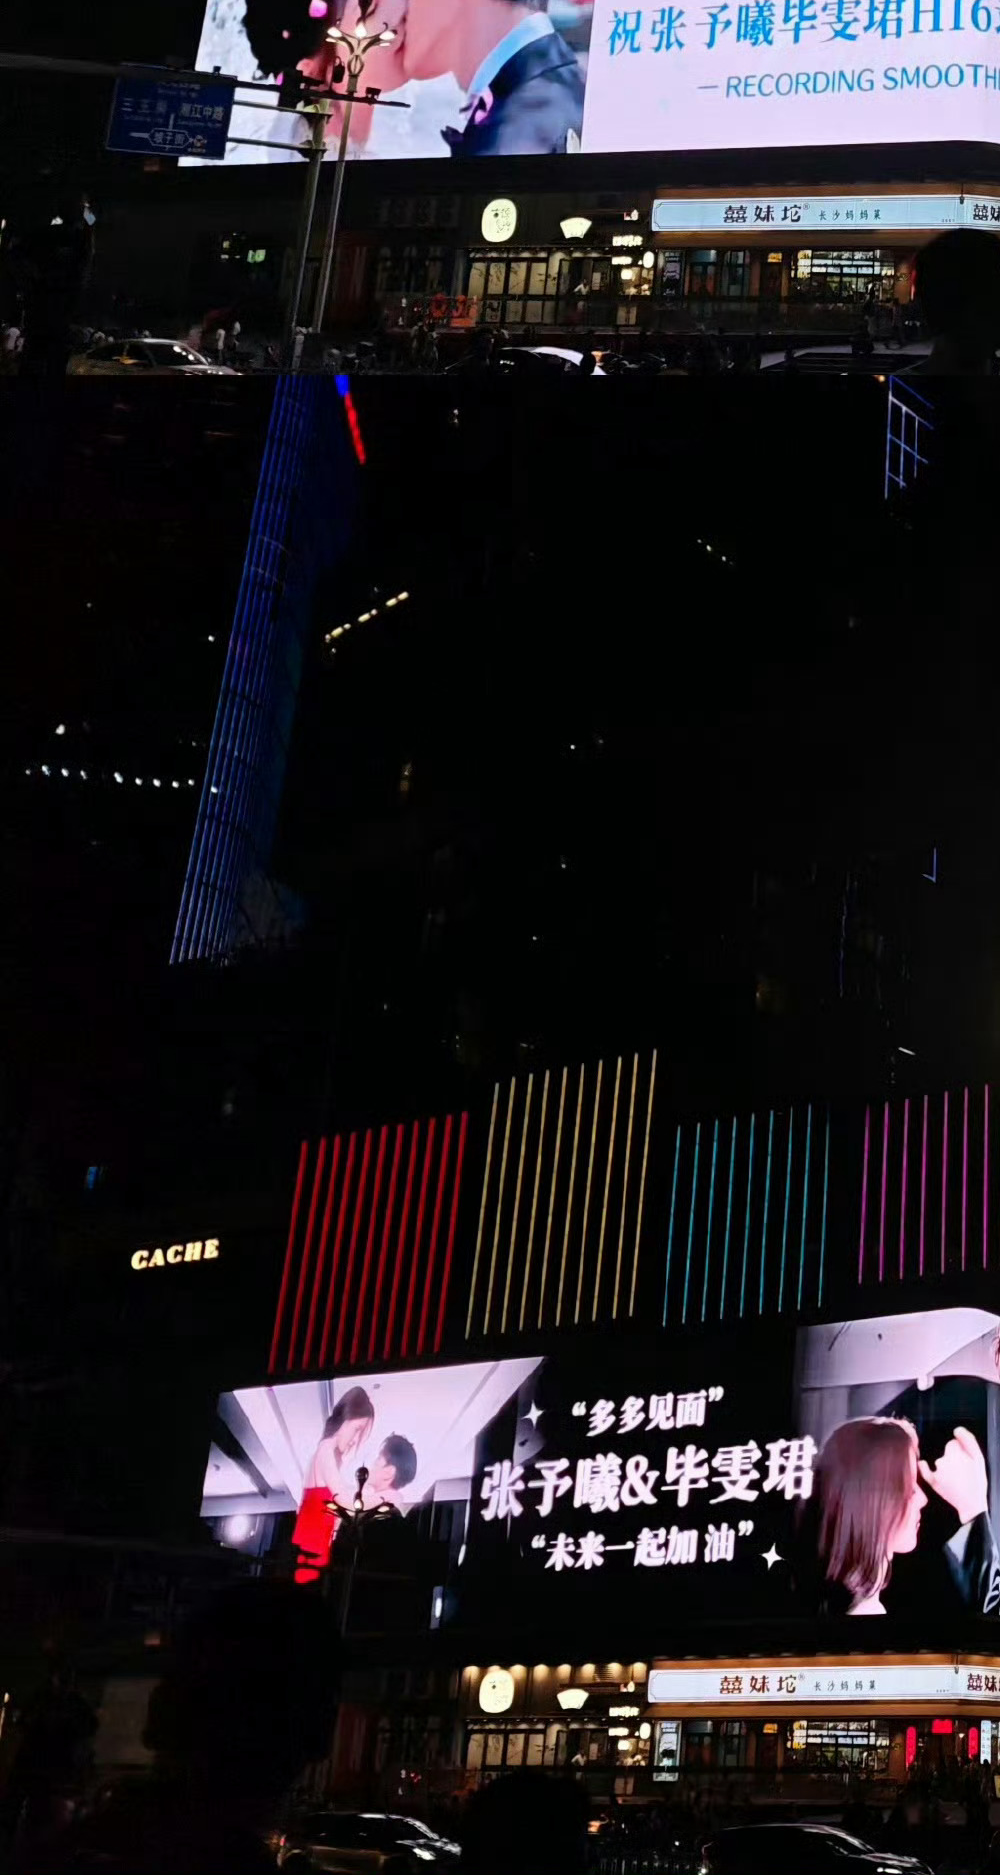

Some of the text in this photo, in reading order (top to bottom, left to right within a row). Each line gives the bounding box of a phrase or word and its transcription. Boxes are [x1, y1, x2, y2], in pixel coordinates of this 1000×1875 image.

[725, 67, 875, 98] RECORDING
[130, 1238, 219, 1271] CACHE
[480, 1435, 818, 1521] 张予曦&毕雯珺
